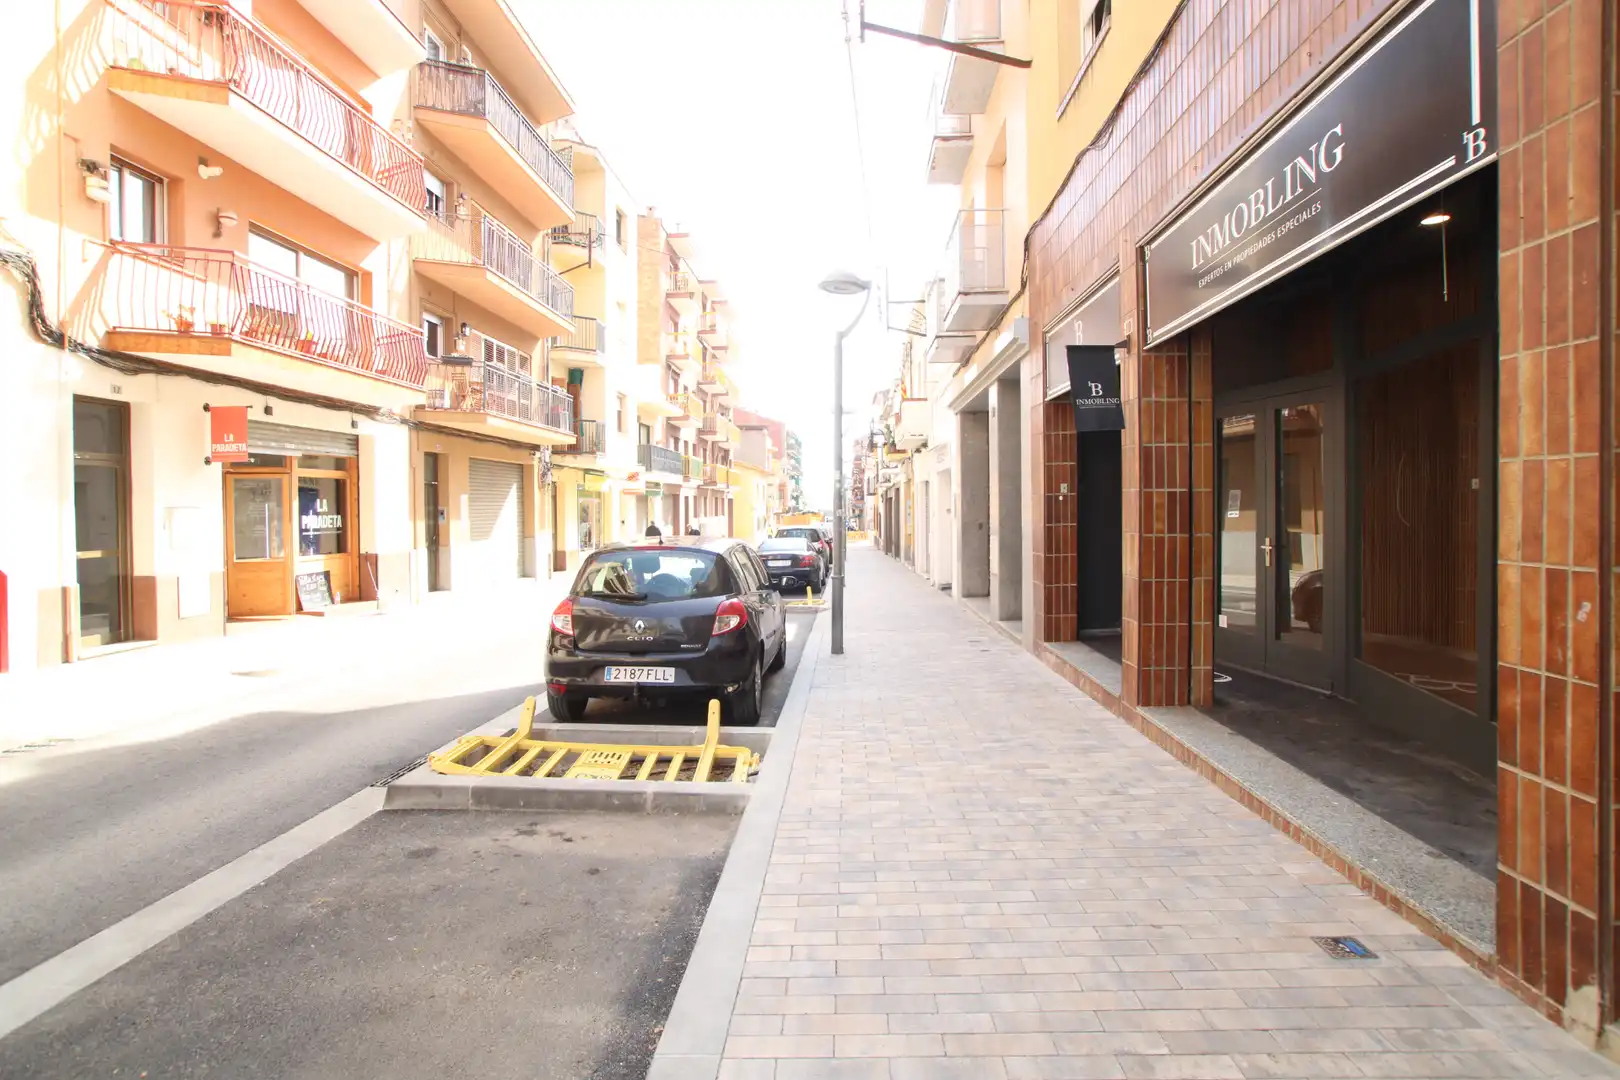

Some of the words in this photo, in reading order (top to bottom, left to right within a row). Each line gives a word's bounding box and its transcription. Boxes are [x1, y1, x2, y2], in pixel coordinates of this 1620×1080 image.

[1190, 123, 1346, 271] INMOBLING
[1198, 267, 1224, 288] EXPERTOS
[1224, 260, 1232, 270] EN
[1233, 232, 1276, 265] PROPIEDADES
[1277, 201, 1321, 237] ESPECIALES
[1076, 397, 1120, 405] INMOBLING
[224, 433, 234, 442] LA
[212, 443, 246, 452] PARADETA
[317, 499, 327, 511] LA
[302, 514, 342, 528] PARADETA
[613, 668, 644, 680] 2187
[646, 669, 669, 681] FLL
